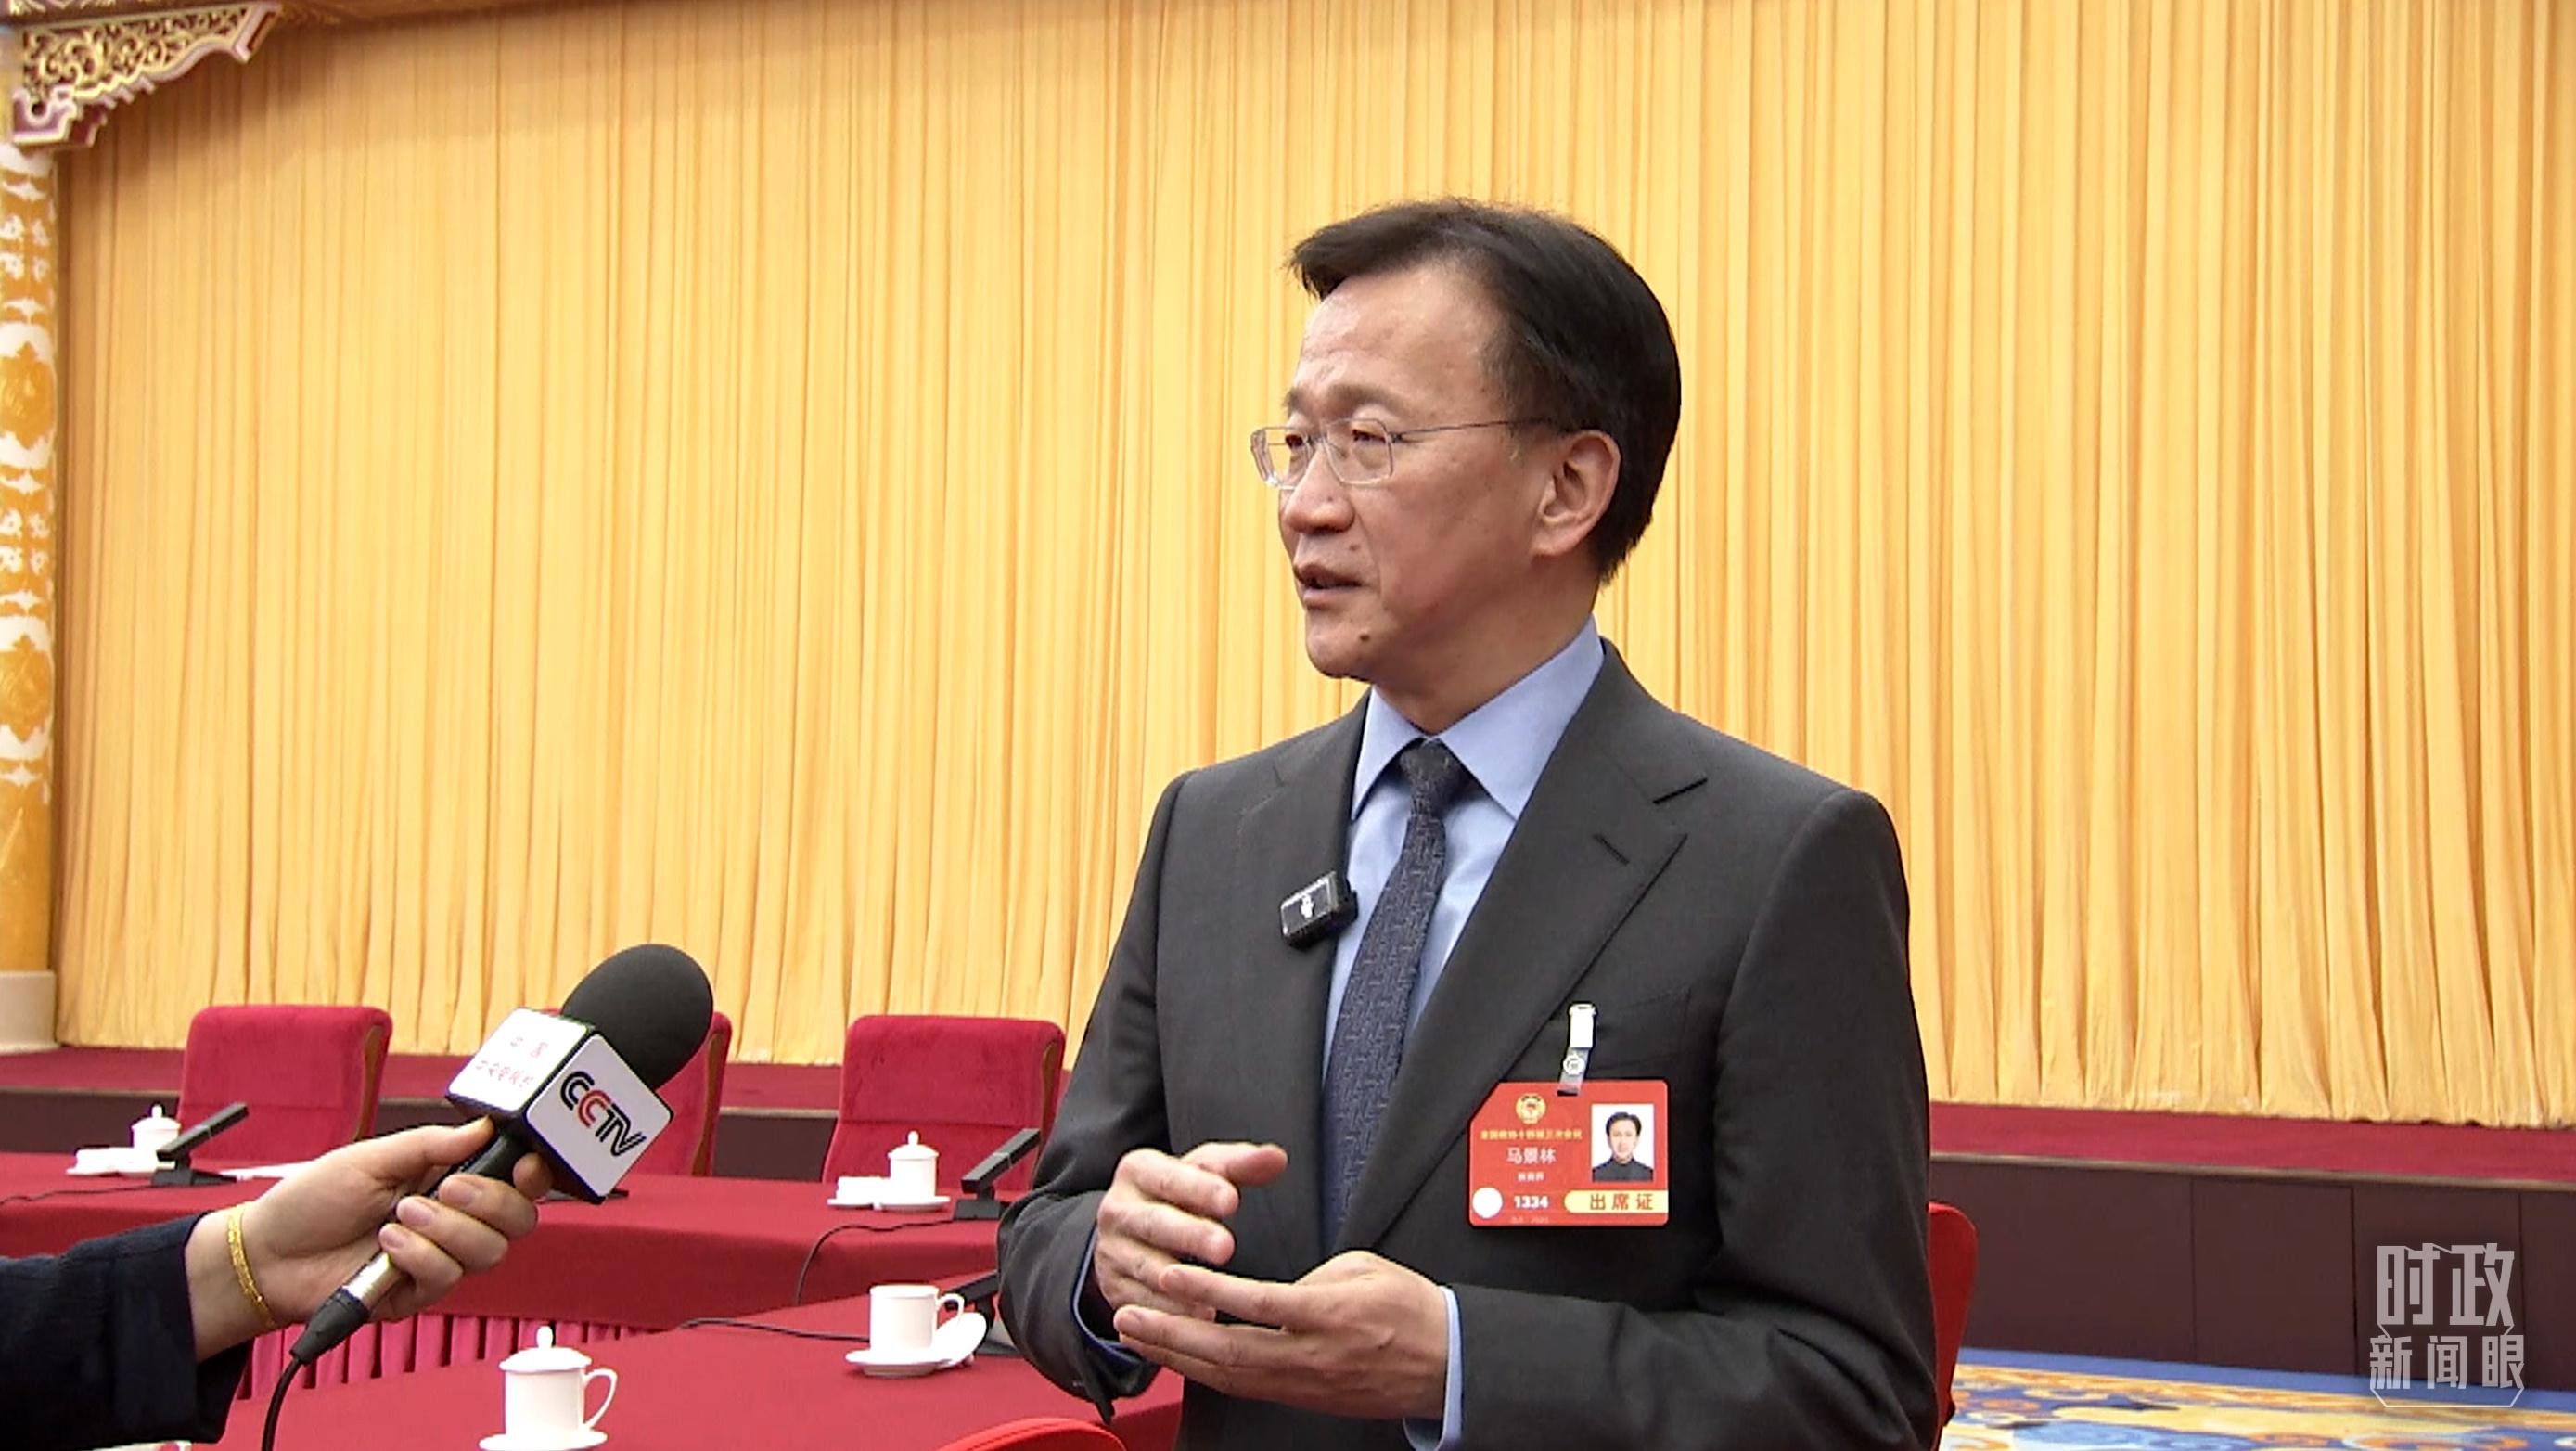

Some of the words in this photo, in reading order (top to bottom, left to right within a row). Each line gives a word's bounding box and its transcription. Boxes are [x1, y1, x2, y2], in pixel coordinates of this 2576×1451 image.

[560, 1071, 647, 1157] CCTV
[1514, 1195, 1549, 1209] 1334
[1590, 1193, 1654, 1211] 出席证
